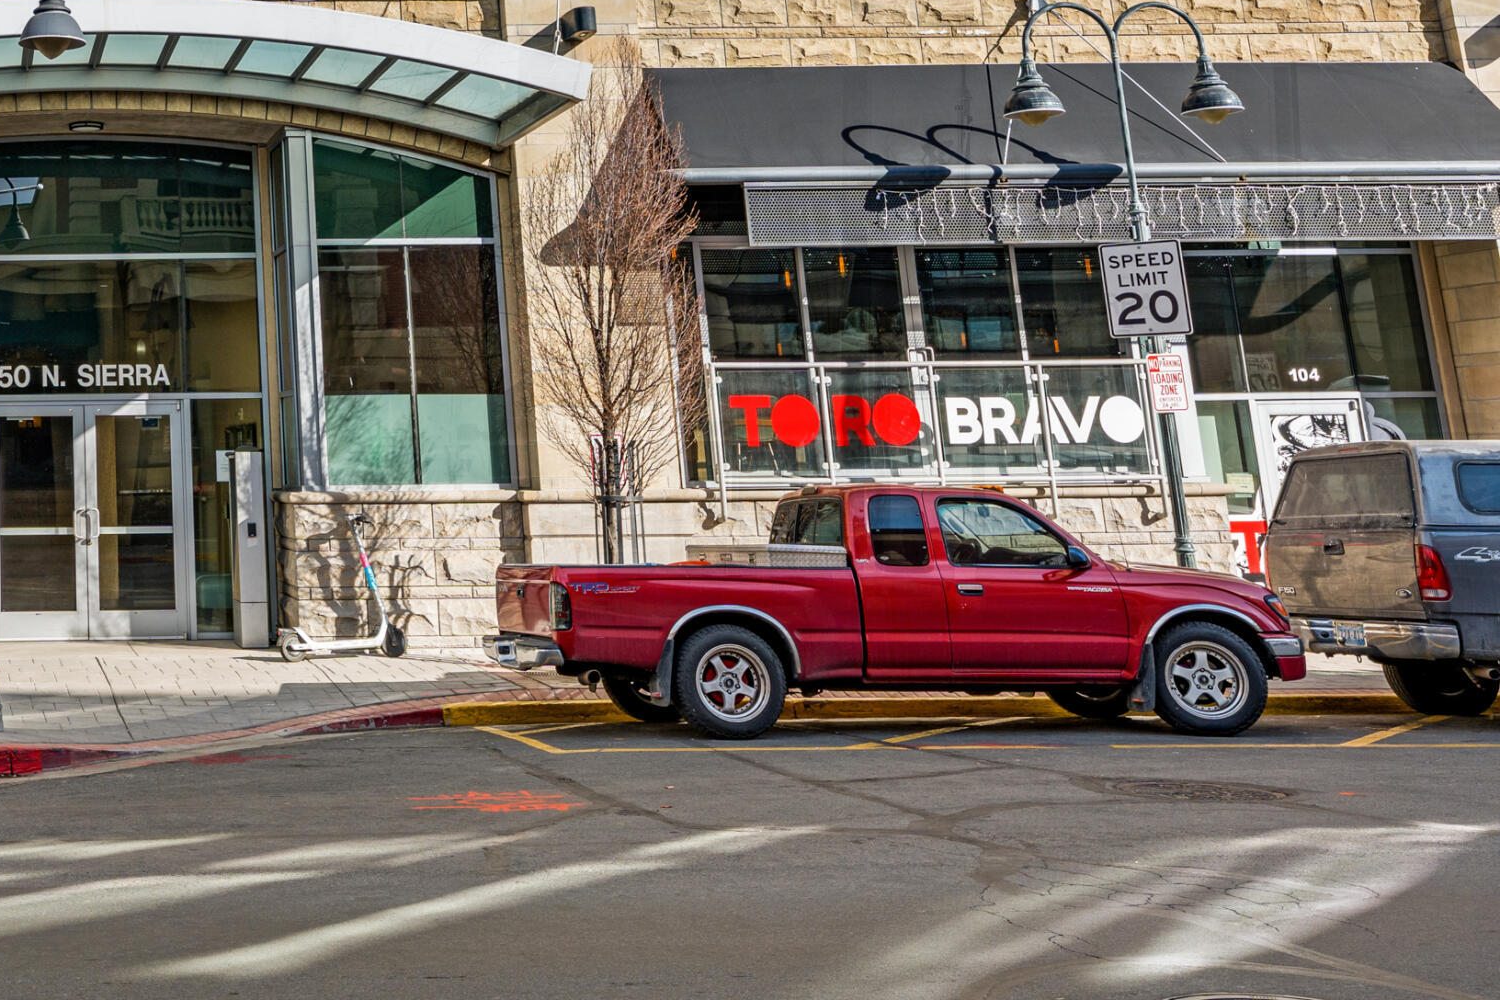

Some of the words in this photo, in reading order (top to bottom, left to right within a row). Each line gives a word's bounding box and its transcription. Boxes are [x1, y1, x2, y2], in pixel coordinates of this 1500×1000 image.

[1108, 251, 1174, 269] SPEED
[1117, 271, 1168, 287] LIMIT
[1115, 290, 1179, 325] 20
[1148, 359, 1159, 370] NO
[1159, 359, 1181, 368] PARKING
[41, 365, 66, 387] N.
[77, 363, 171, 387] SIERRA
[1152, 373, 1183, 384] LOADING
[1289, 368, 1320, 382] 104
[1160, 385, 1179, 395] ZONE
[729, 393, 921, 447] TORO
[945, 395, 1145, 444] BRAVO
[569, 582, 610, 594] TRD
